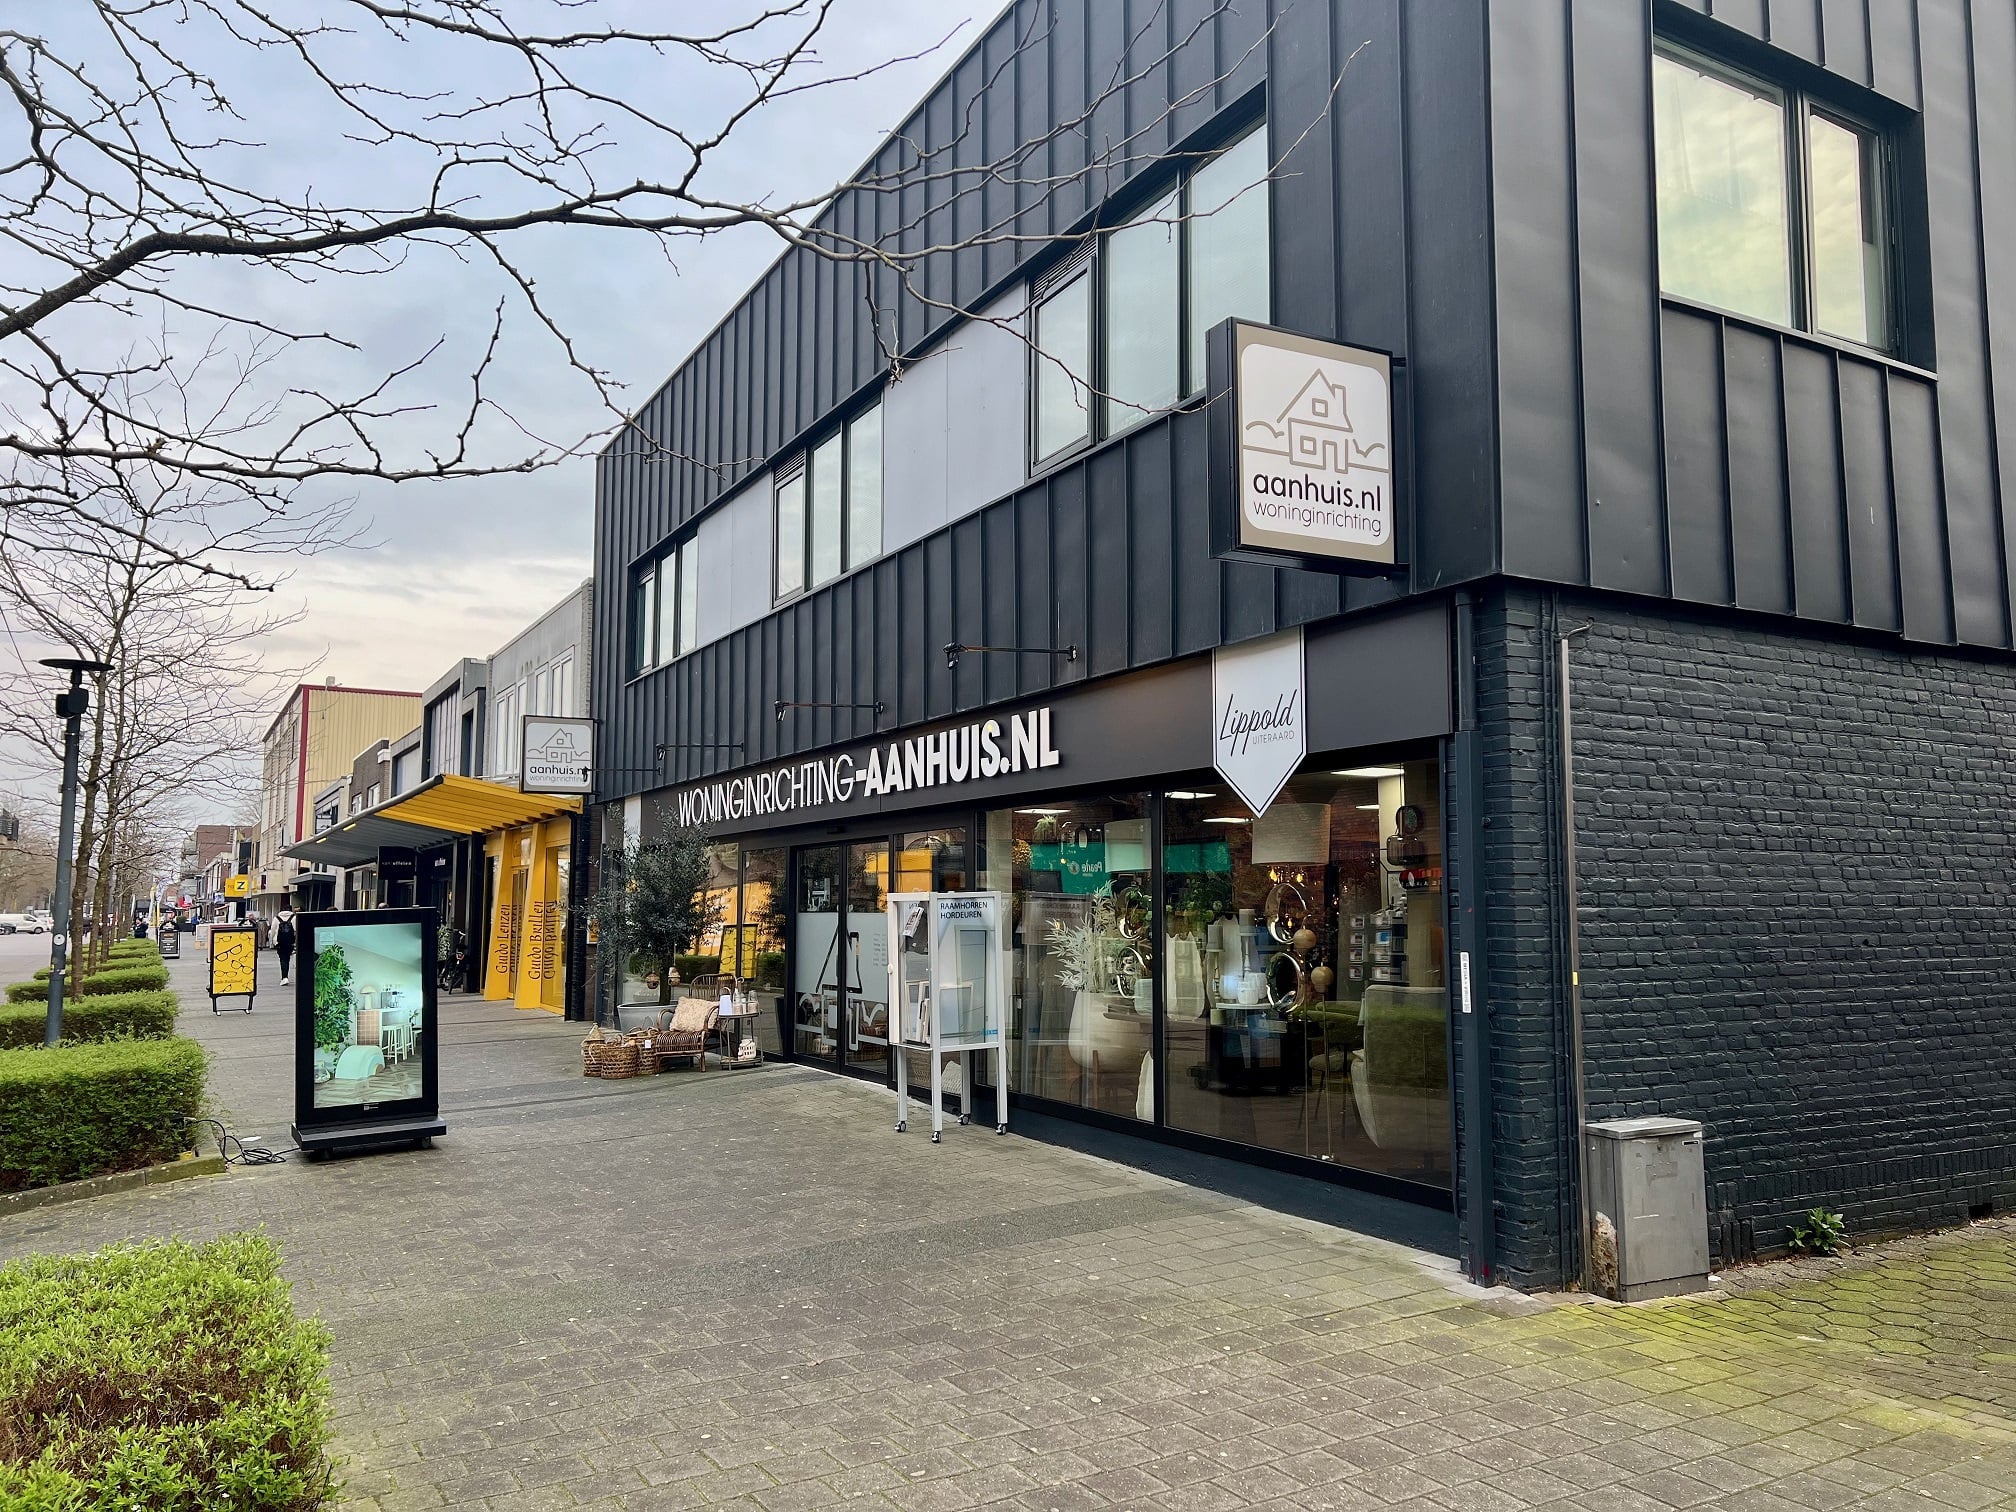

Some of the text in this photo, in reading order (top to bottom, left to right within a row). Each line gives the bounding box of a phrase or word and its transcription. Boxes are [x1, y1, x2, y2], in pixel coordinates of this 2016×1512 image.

[1252, 473, 1382, 512] aanhuis.nl
[1252, 501, 1383, 537] woninginrichting
[1219, 688, 1298, 757] Lippold
[1252, 730, 1295, 745] UITERAARD
[529, 764, 586, 776] aanhuis.n
[529, 775, 585, 784] woninginrichtin
[940, 901, 988, 910] RAAMHORREN
[940, 910, 982, 920] HORDEUREN
[495, 904, 511, 974] Guido Lenzen
[527, 946, 542, 980] Guido
